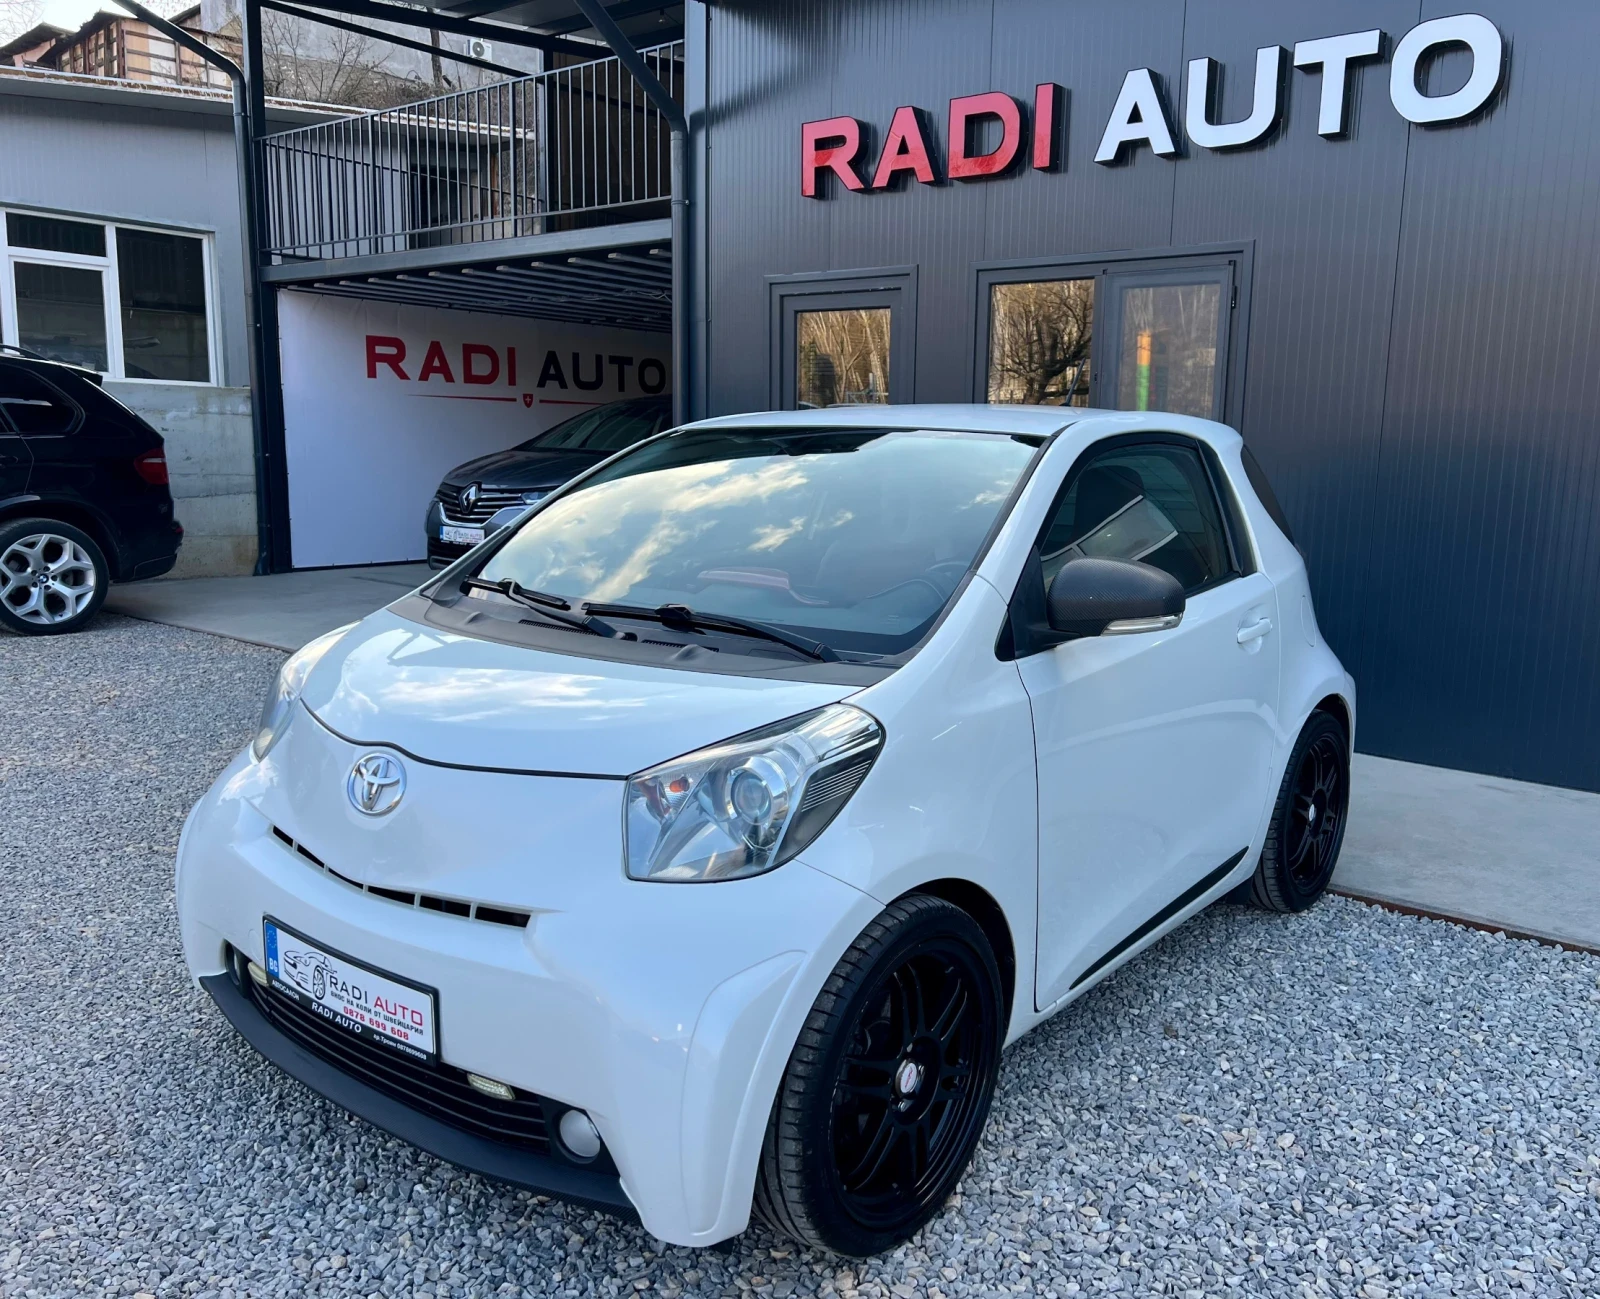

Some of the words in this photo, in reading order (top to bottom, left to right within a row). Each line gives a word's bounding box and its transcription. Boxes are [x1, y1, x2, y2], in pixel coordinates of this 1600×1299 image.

[800, 82, 1058, 198] RADI
[1093, 13, 1505, 165] AUTO
[365, 335, 517, 387] RADI
[536, 350, 667, 395] AUTO
[268, 957, 279, 973] BG
[311, 1001, 334, 1019] RADI
[335, 1014, 362, 1033] AUTO
[329, 974, 368, 1005] RADI
[373, 995, 423, 1027] AUTO
[346, 998, 354, 1007] НА
[356, 1002, 372, 1014] КОЛИ
[373, 1010, 381, 1018] ОТ
[383, 1014, 424, 1036] ШВЕЙЦАРИЯ
[343, 1005, 366, 1022] 0878
[368, 1017, 387, 1031] 699
[390, 1026, 409, 1041] 608
